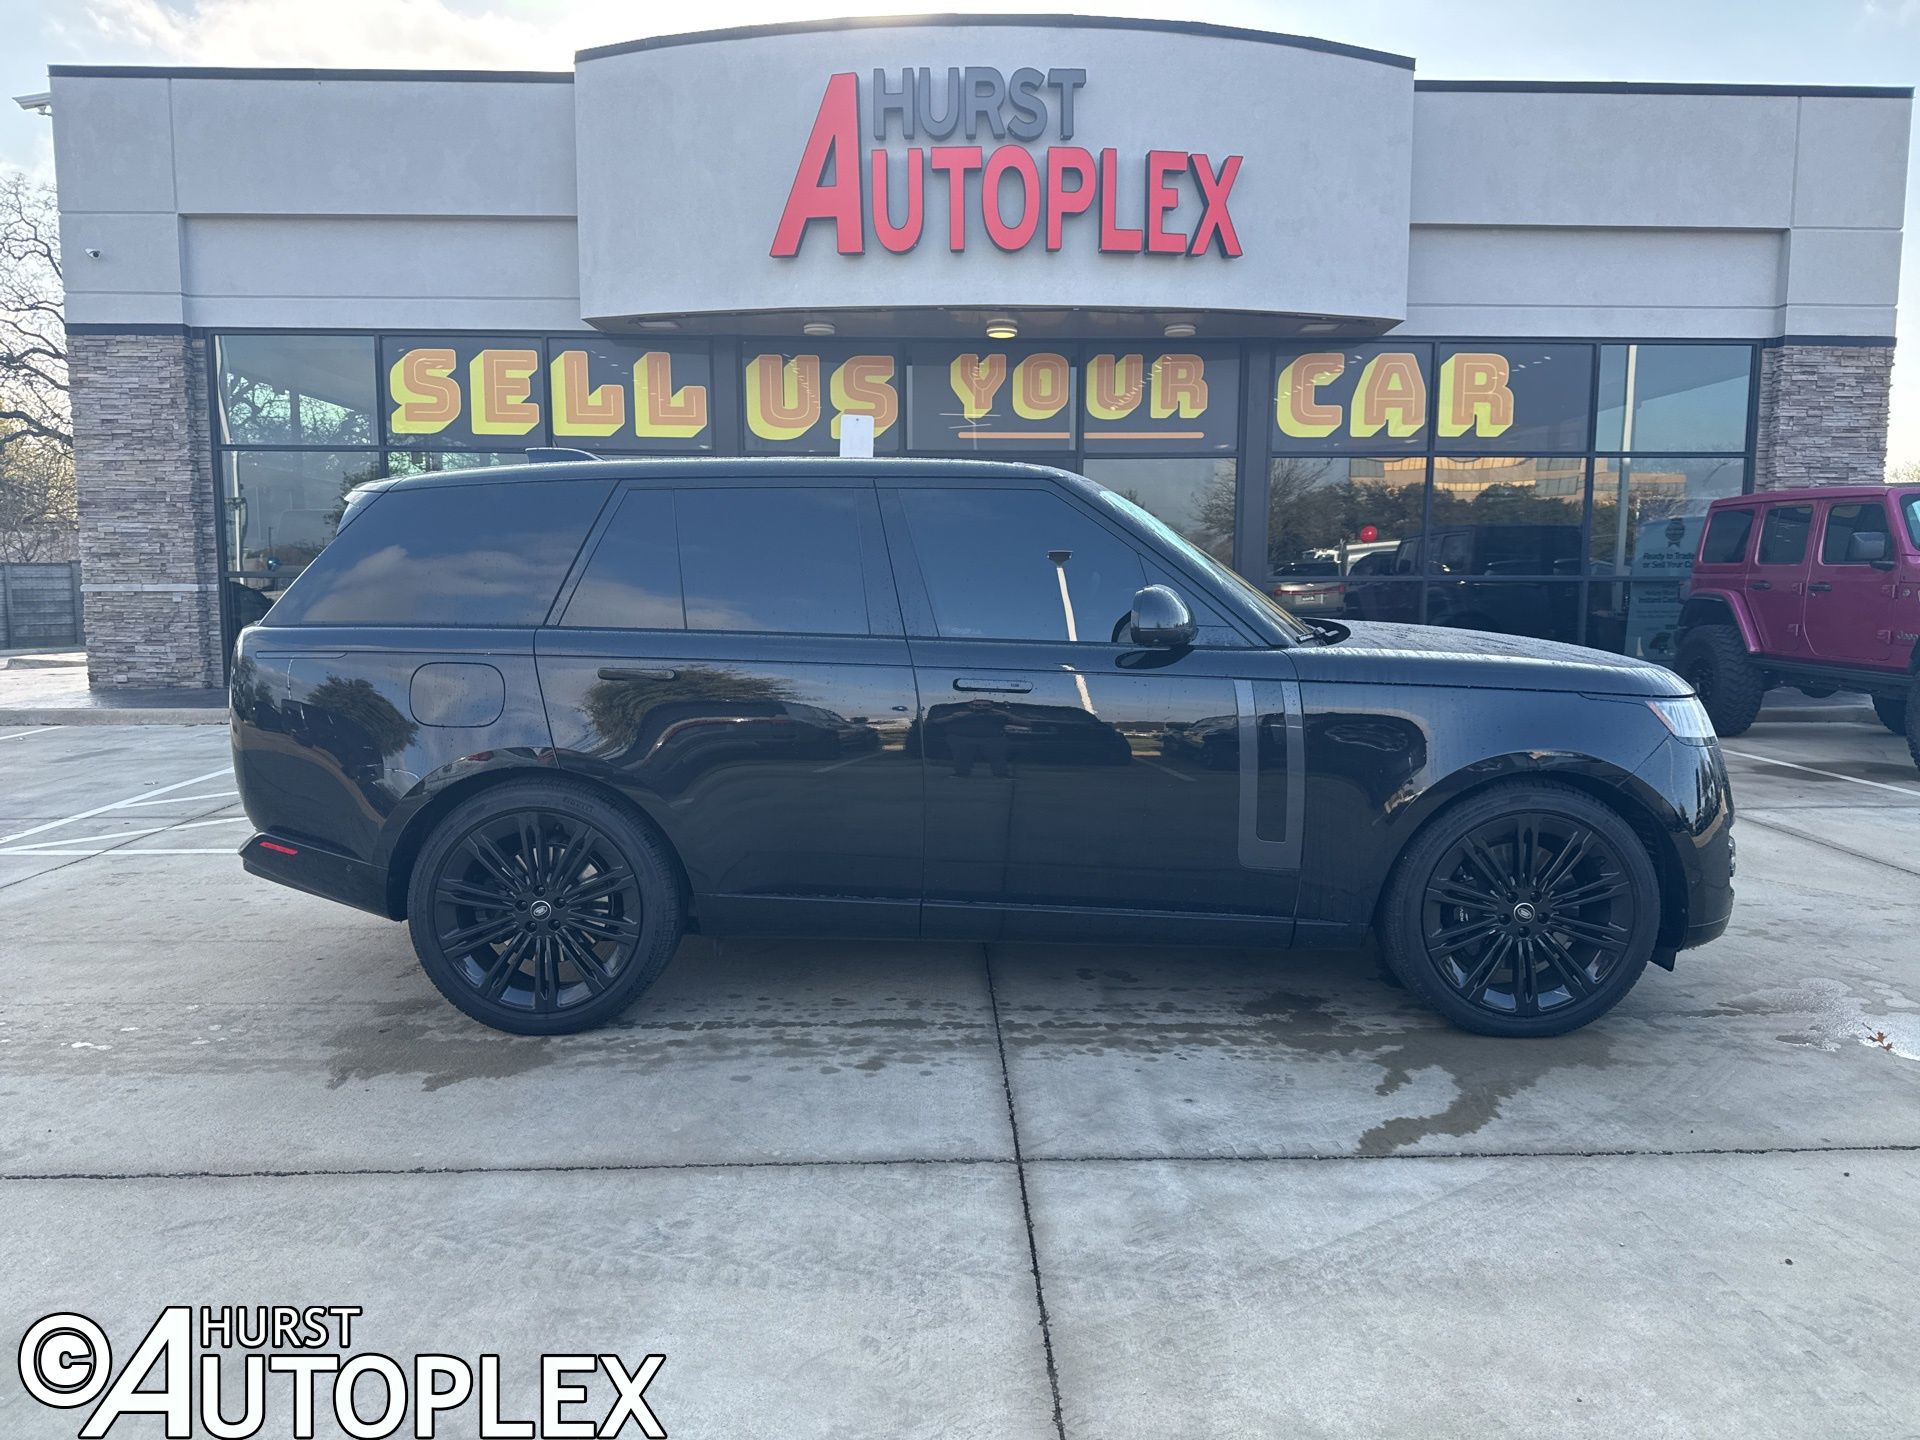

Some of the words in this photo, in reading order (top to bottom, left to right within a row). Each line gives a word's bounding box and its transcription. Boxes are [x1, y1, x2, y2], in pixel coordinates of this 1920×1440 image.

[873, 67, 1087, 141] HURST
[769, 72, 1244, 258] AUTOPLEX
[390, 348, 708, 437] SELL
[745, 353, 898, 440] US
[950, 352, 1208, 420] YOUR
[1276, 351, 1514, 438] CAR
